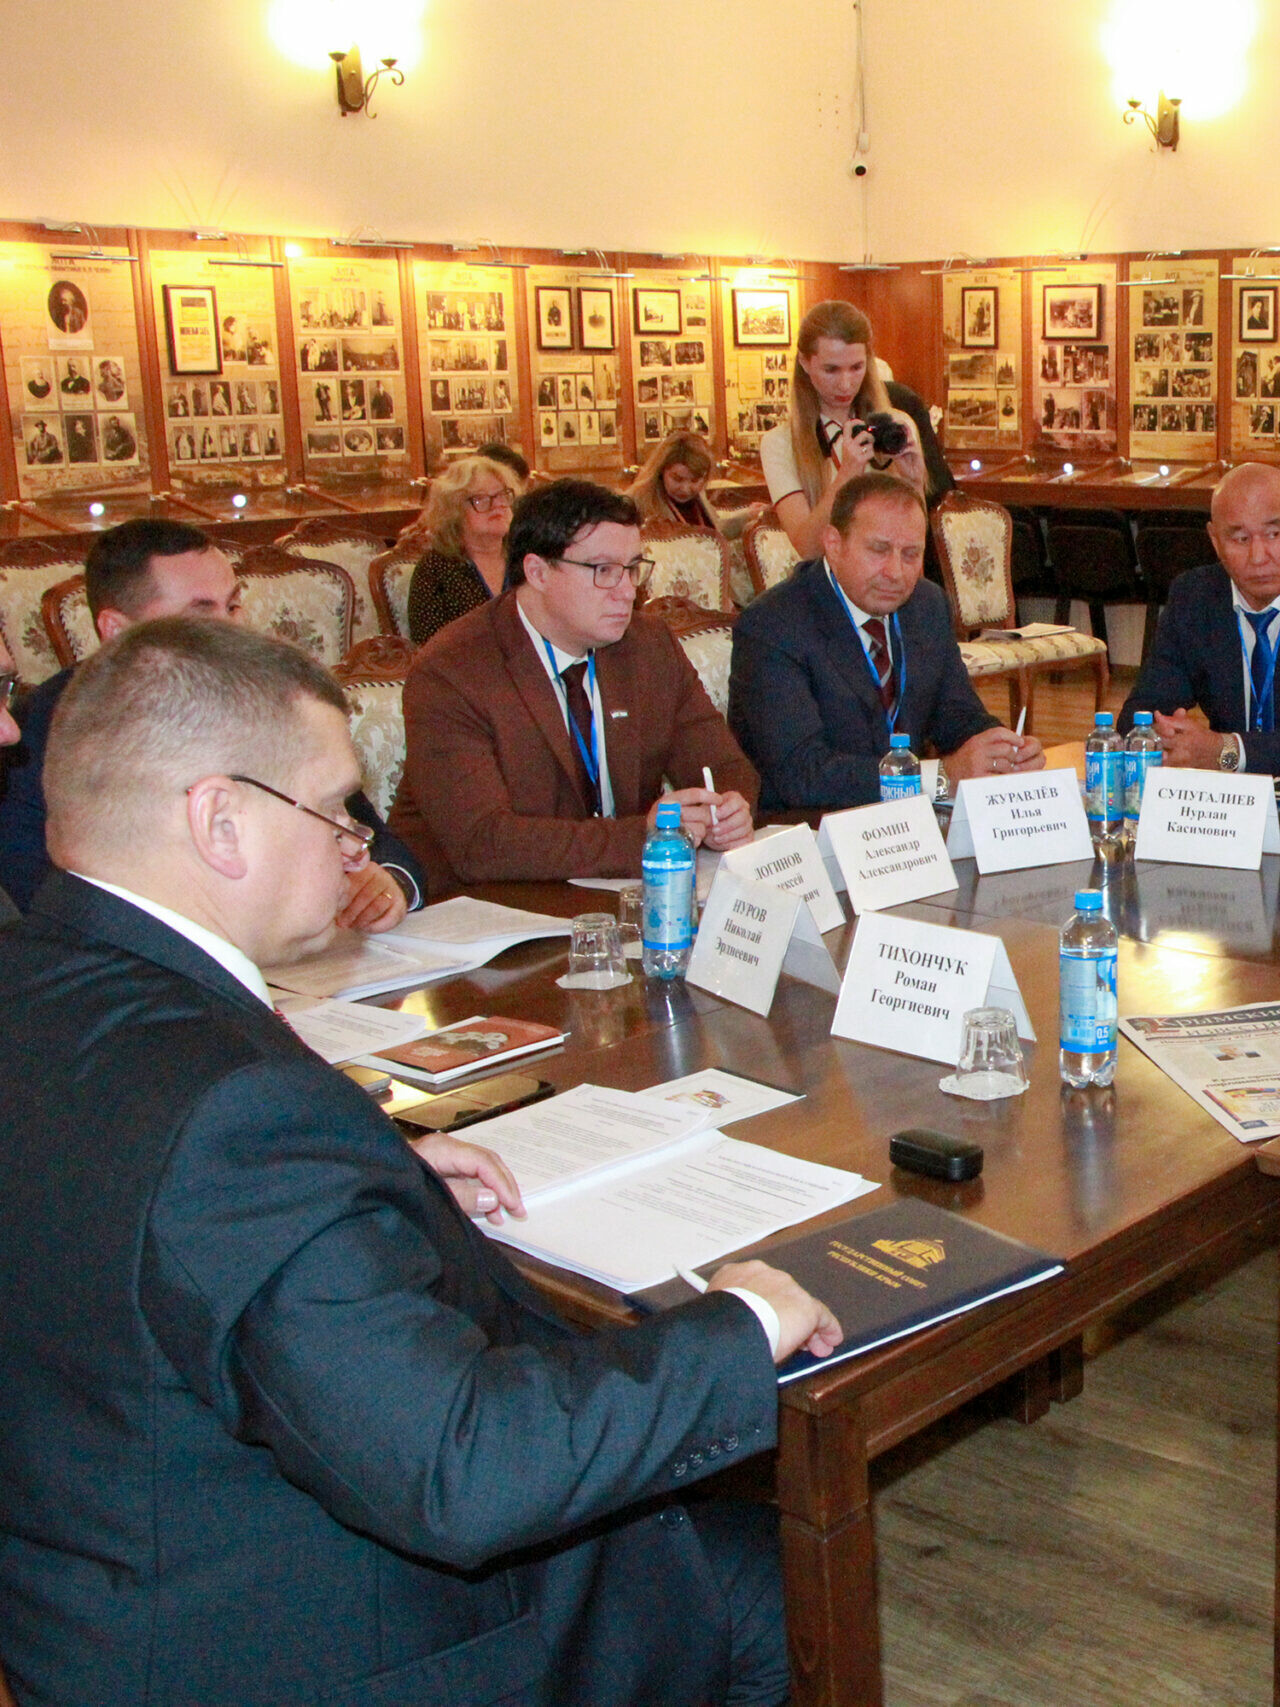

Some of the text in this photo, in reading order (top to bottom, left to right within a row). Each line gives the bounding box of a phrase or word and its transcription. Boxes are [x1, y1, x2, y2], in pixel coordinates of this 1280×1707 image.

[985, 786, 1059, 806] ЖУРАВЛЁВ
[1158, 787, 1255, 806] СУПУГАЛИЕВ
[1011, 808, 1042, 820] Илья
[1180, 806, 1227, 821] Нурлан
[861, 821, 910, 841] ФОМИН
[992, 821, 1067, 841] Григорьевич
[1167, 821, 1236, 838] Касимович
[865, 840, 920, 860] Александр
[755, 852, 802, 880] ЛОГИНОВ
[858, 854, 938, 880] Александрович
[732, 899, 767, 922] НУРОВ
[724, 918, 763, 944] Николай
[879, 943, 968, 975] ТИХОНЧУК
[894, 970, 937, 993] Роман
[870, 988, 950, 1020] Георгиевич
